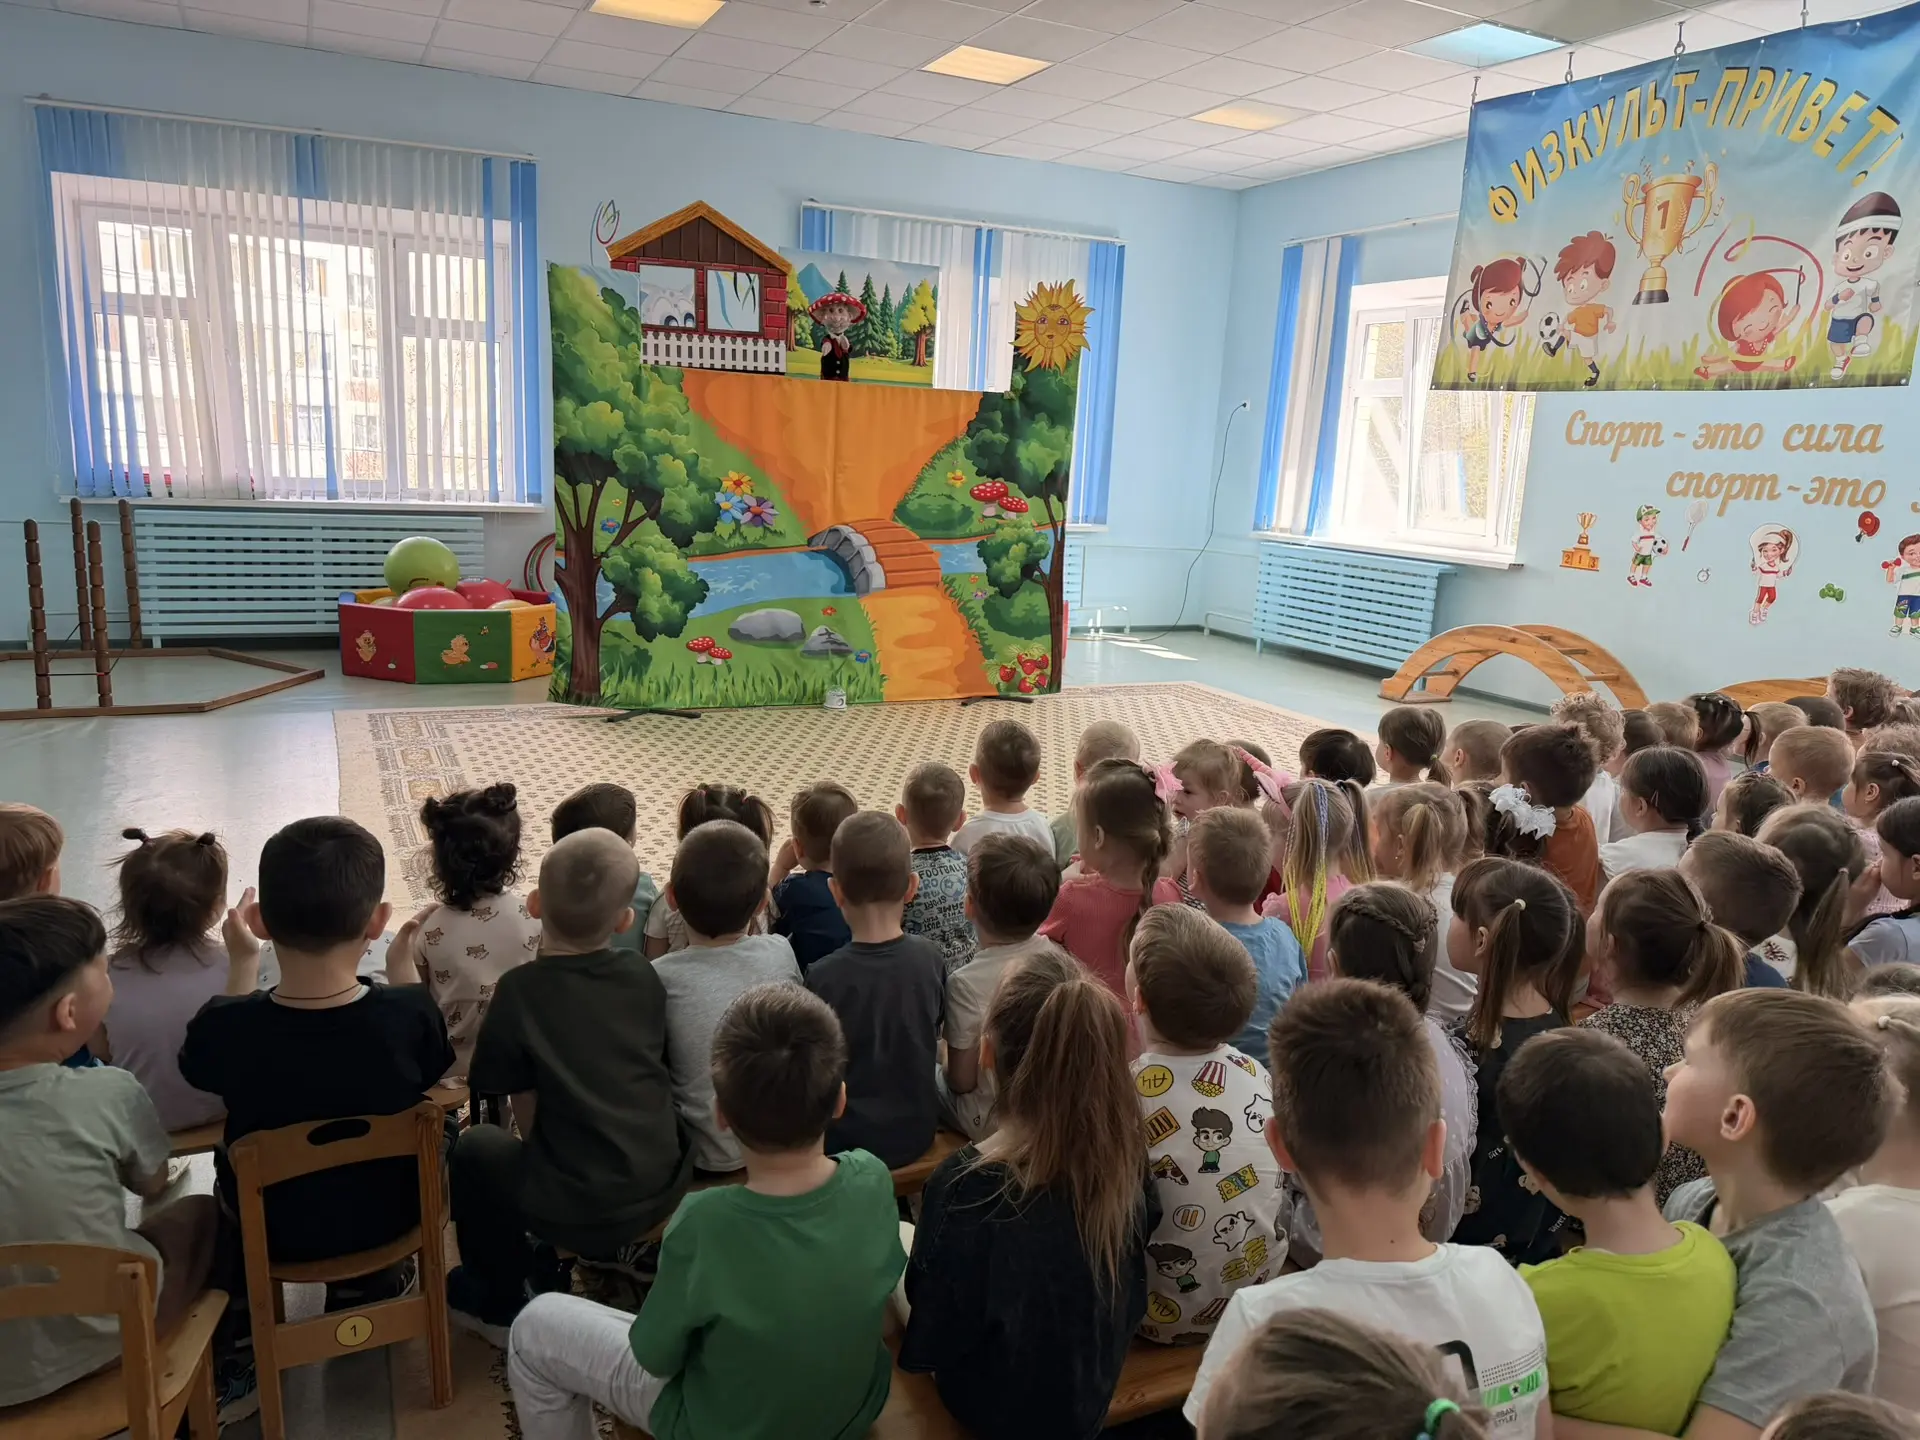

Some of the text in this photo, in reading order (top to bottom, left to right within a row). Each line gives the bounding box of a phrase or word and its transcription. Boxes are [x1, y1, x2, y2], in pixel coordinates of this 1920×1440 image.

[1487, 66, 1904, 224] ФИЗКУЛЬТ-ПРИВЕТ!
[1657, 200, 1671, 230] 1
[1565, 409, 1664, 463] Спорт
[1692, 421, 1764, 450] это
[1782, 422, 1885, 453] сила
[919, 863, 964, 880] FOOTBALL
[350, 1323, 357, 1338] 1
